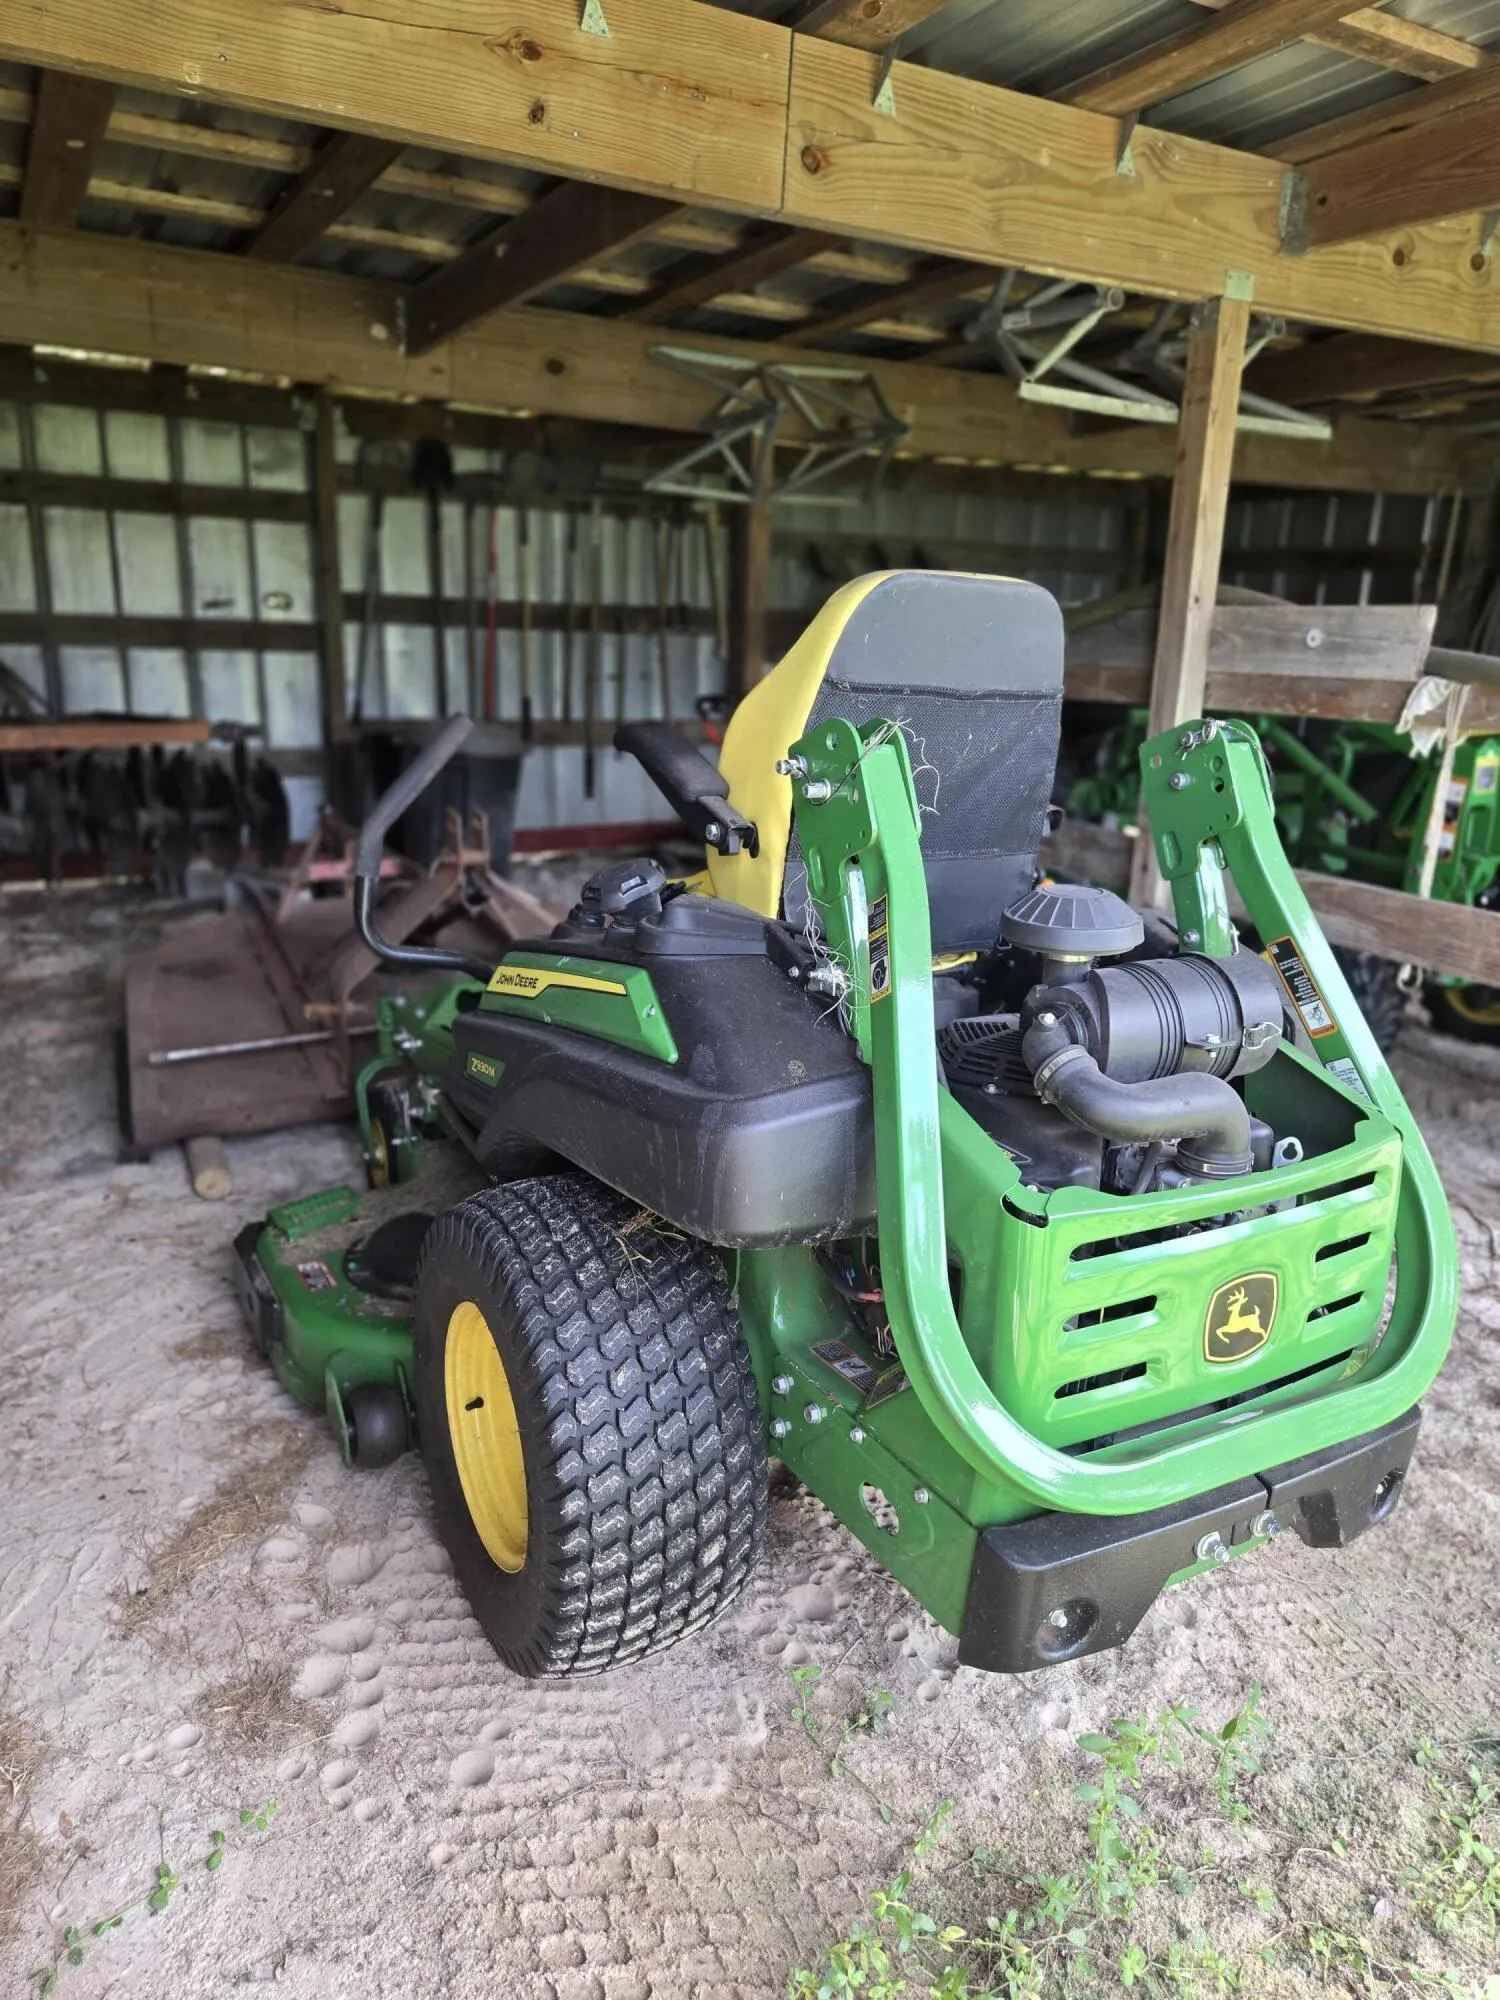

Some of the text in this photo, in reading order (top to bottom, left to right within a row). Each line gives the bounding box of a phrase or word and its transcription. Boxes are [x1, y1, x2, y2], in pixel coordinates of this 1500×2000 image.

[496, 971, 539, 989] JOHN DEERE
[471, 1057, 495, 1077] Z930M
